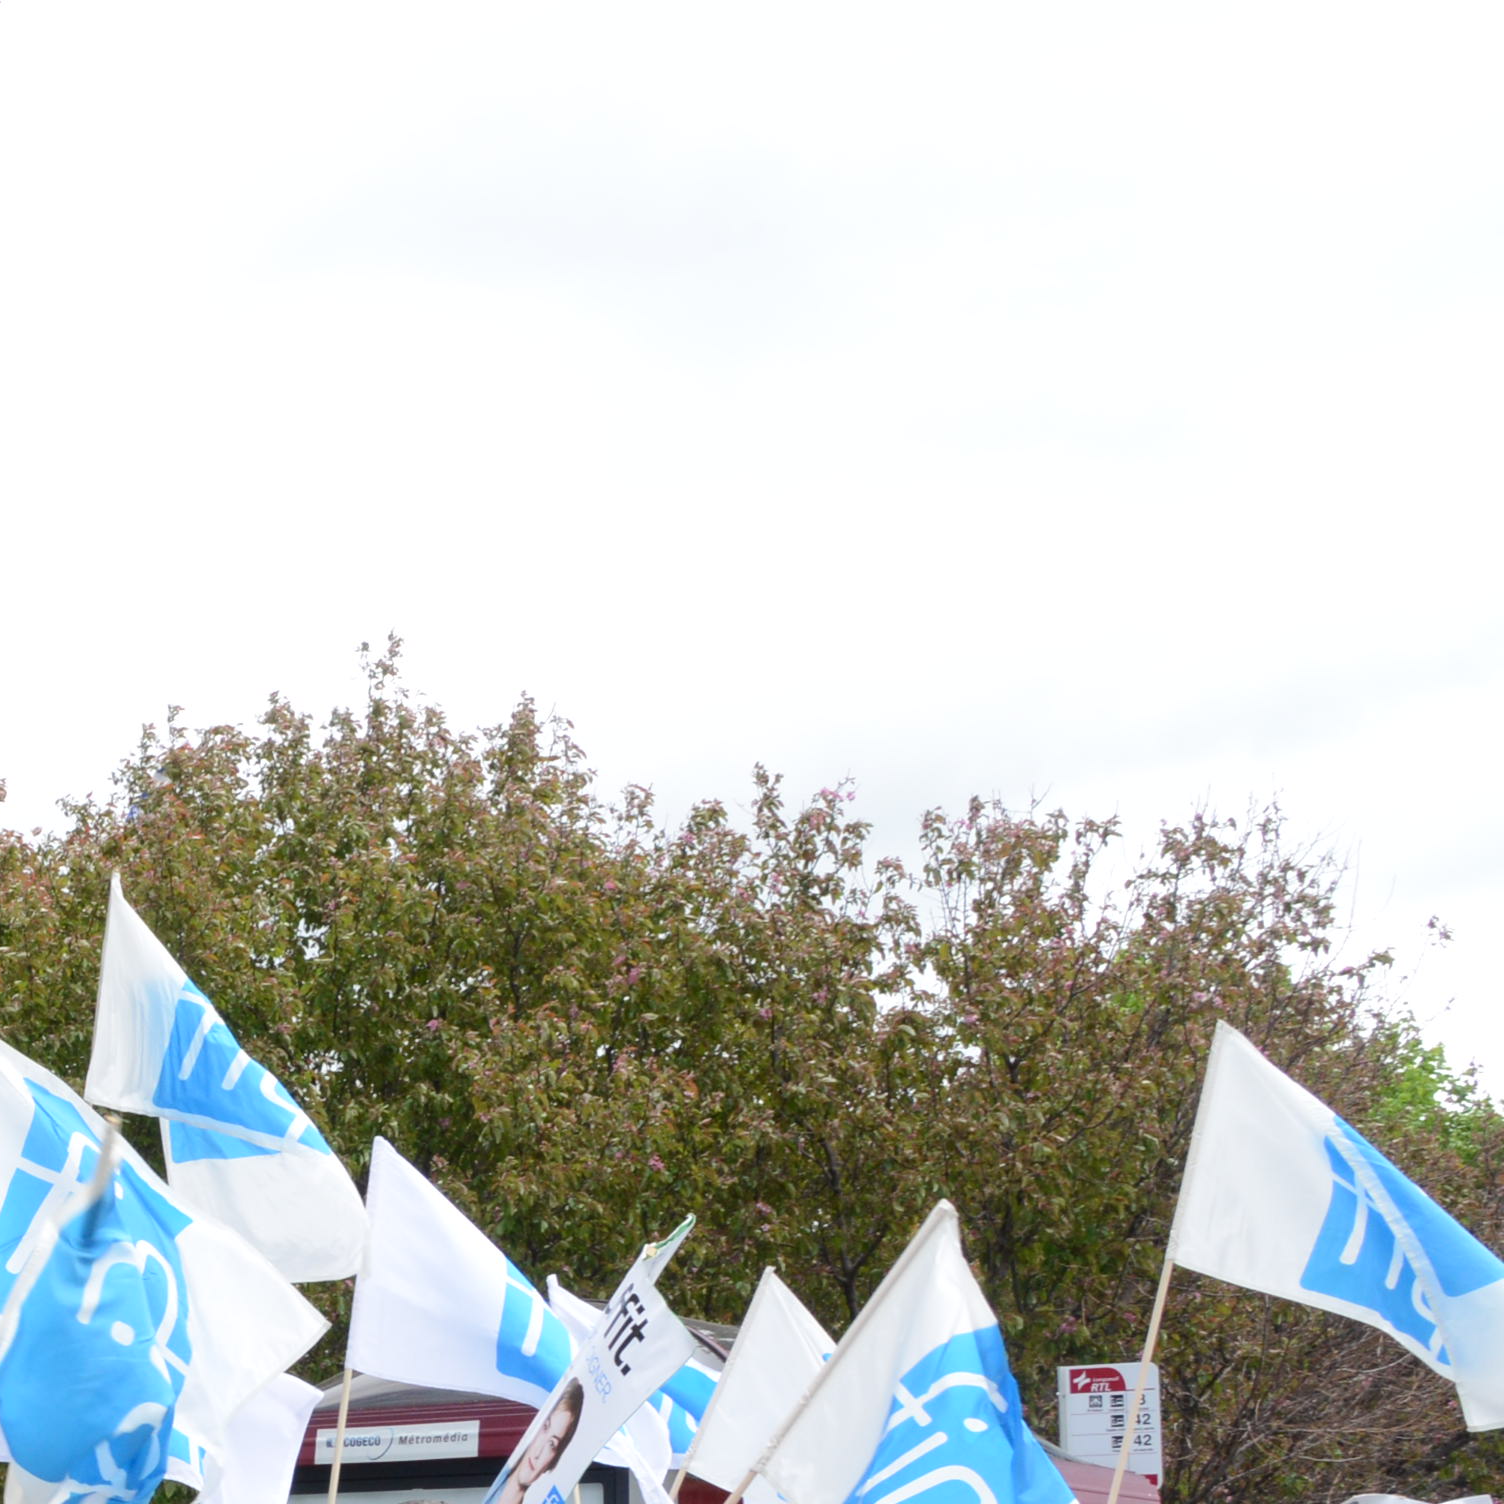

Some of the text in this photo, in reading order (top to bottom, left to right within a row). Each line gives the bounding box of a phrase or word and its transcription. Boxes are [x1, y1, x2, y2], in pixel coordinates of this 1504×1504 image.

[603, 1283, 649, 1376] ffit.
[1090, 1382, 1112, 1392] RTL
[398, 1431, 469, 1446] Métromédia
[1133, 1434, 1152, 1446] 42
